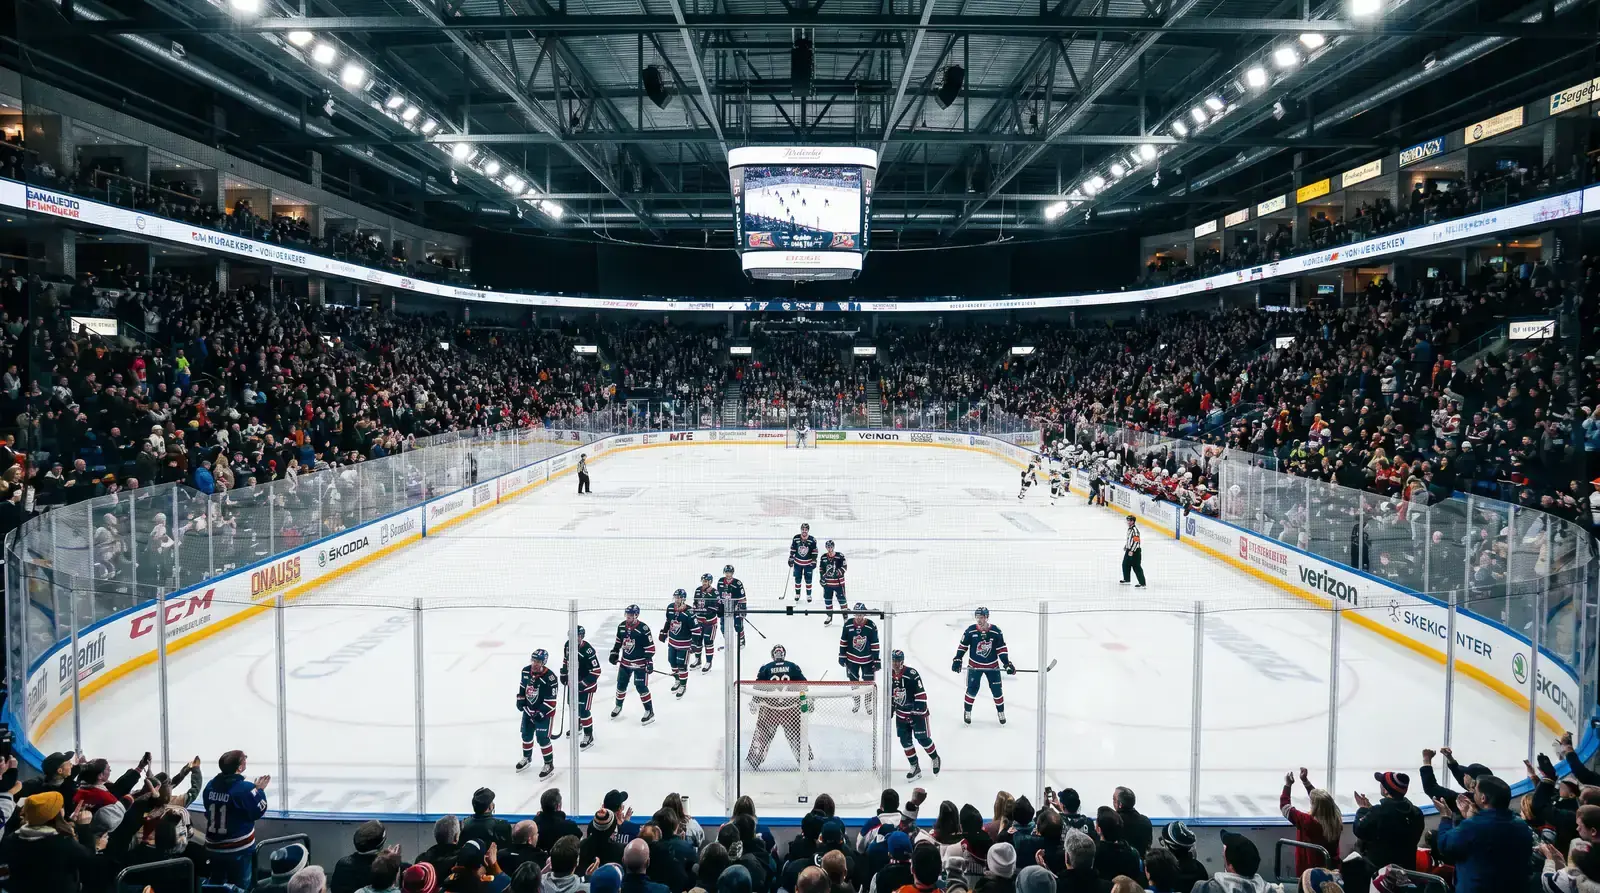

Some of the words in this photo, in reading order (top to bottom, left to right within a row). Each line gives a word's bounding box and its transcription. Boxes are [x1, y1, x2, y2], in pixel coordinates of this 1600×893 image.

[1299, 564, 1358, 606] verizon
[129, 588, 216, 639] CCM
[1404, 611, 1493, 660] SKEKICNTER
[208, 803, 228, 834] 11
